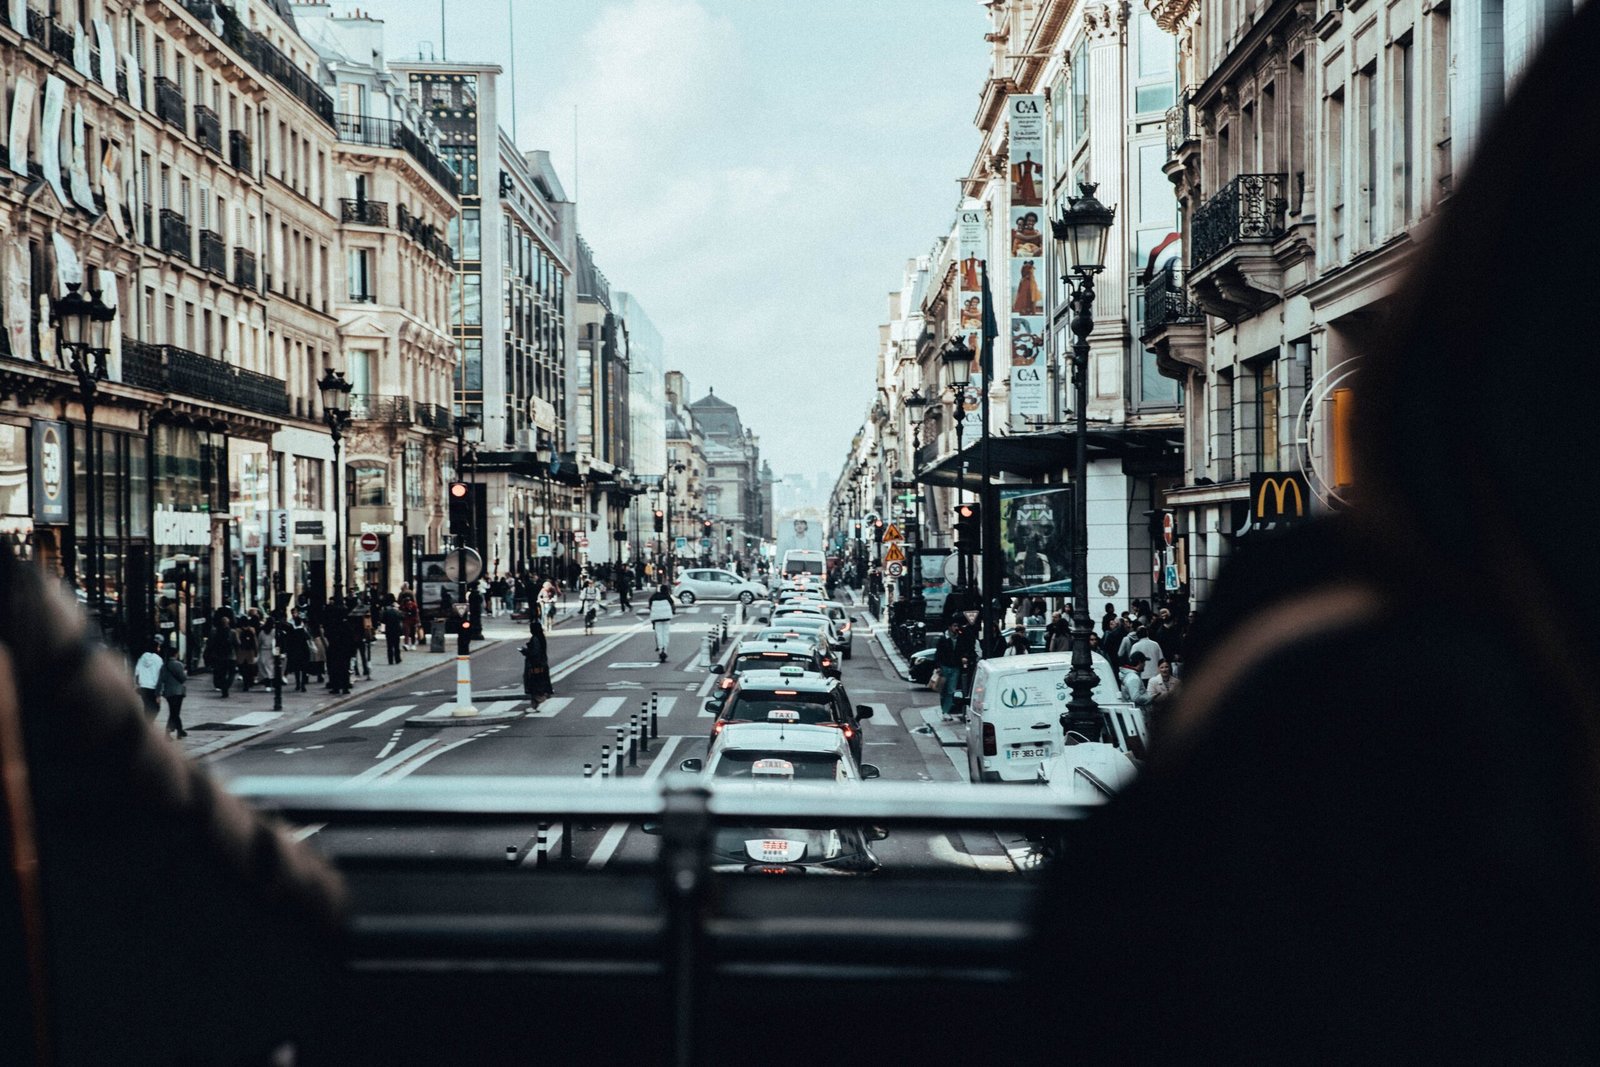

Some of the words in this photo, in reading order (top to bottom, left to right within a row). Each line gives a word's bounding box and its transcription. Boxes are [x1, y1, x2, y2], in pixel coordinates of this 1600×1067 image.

[1015, 100, 1039, 114] C&A
[962, 213, 980, 223] C&A
[1017, 368, 1040, 381] C&A
[1011, 750, 1020, 758] FF
